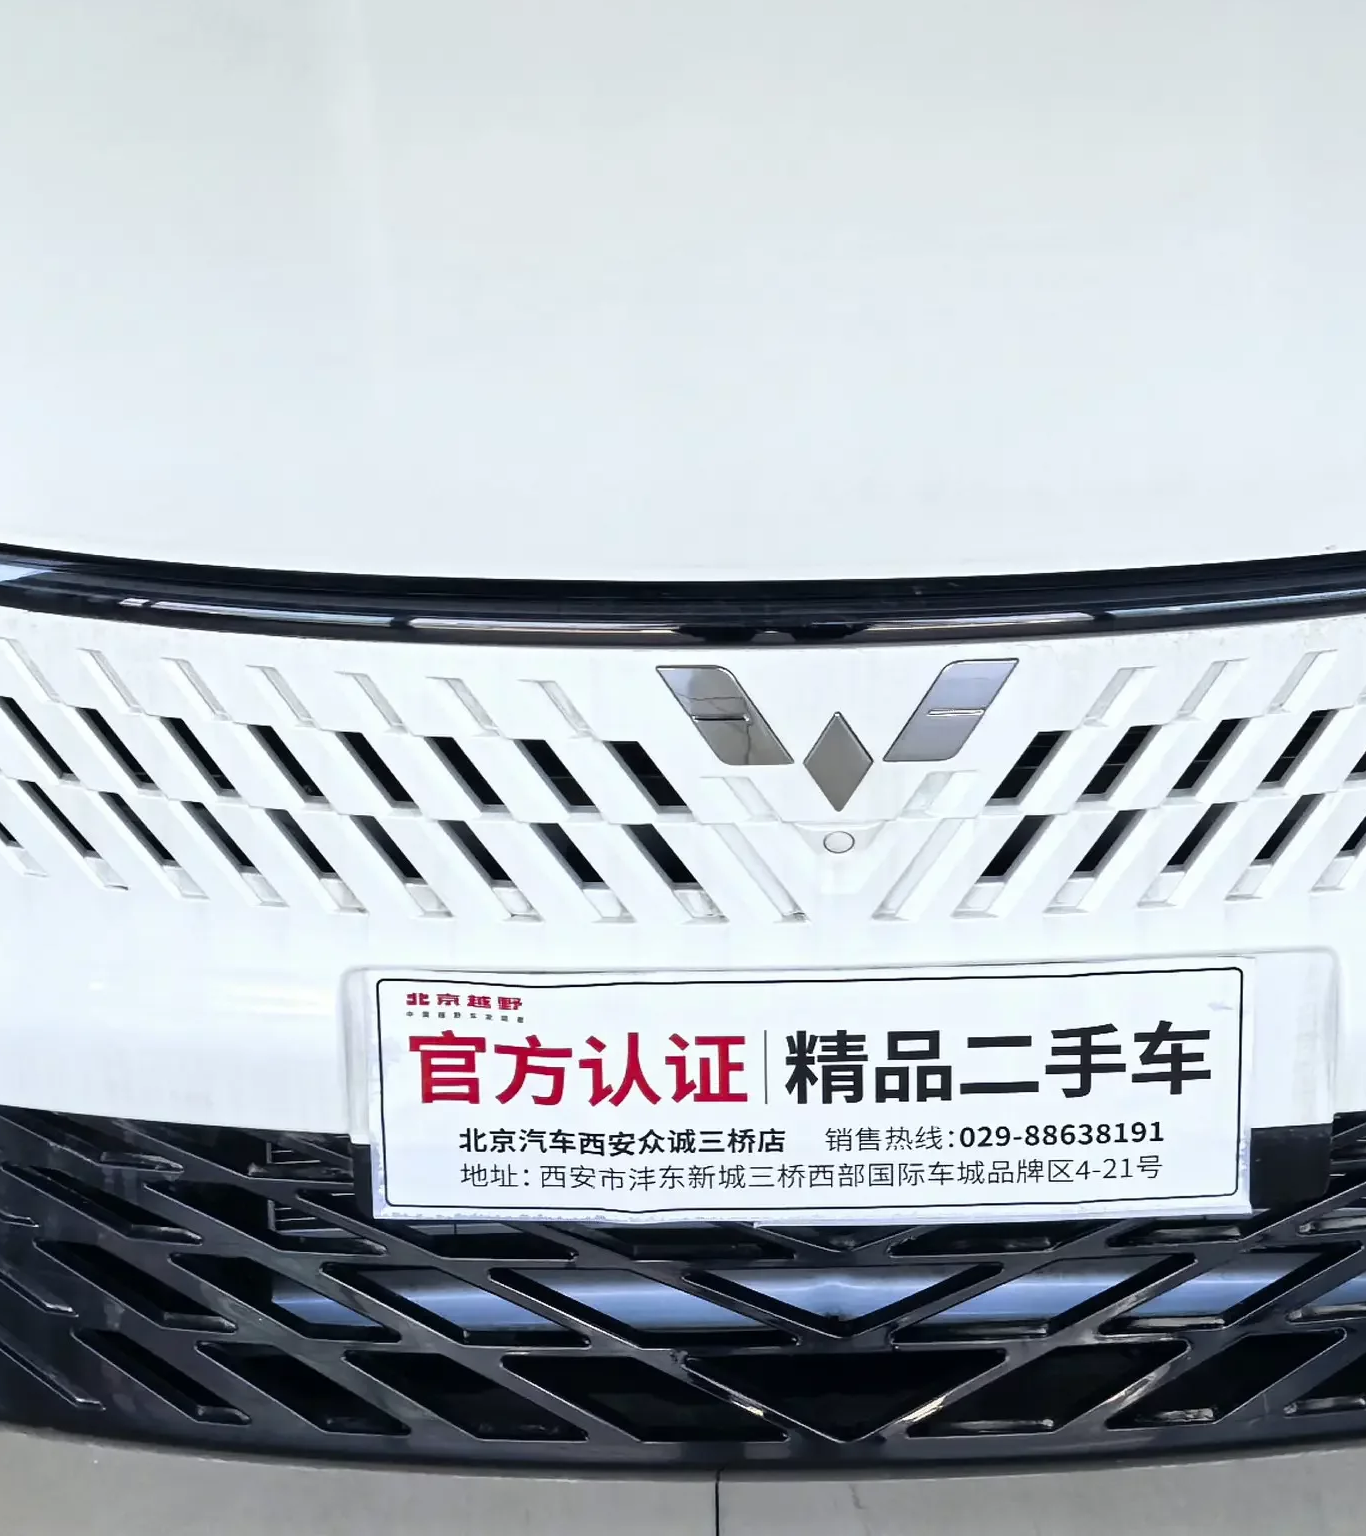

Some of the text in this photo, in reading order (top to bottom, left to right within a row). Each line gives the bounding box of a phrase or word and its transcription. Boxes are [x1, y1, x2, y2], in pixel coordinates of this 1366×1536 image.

[406, 993, 522, 1010] 北京越野
[409, 1020, 1212, 1107] 官方认证 精品二手车
[459, 1128, 786, 1156] 北京汽车西安众诚三桥店
